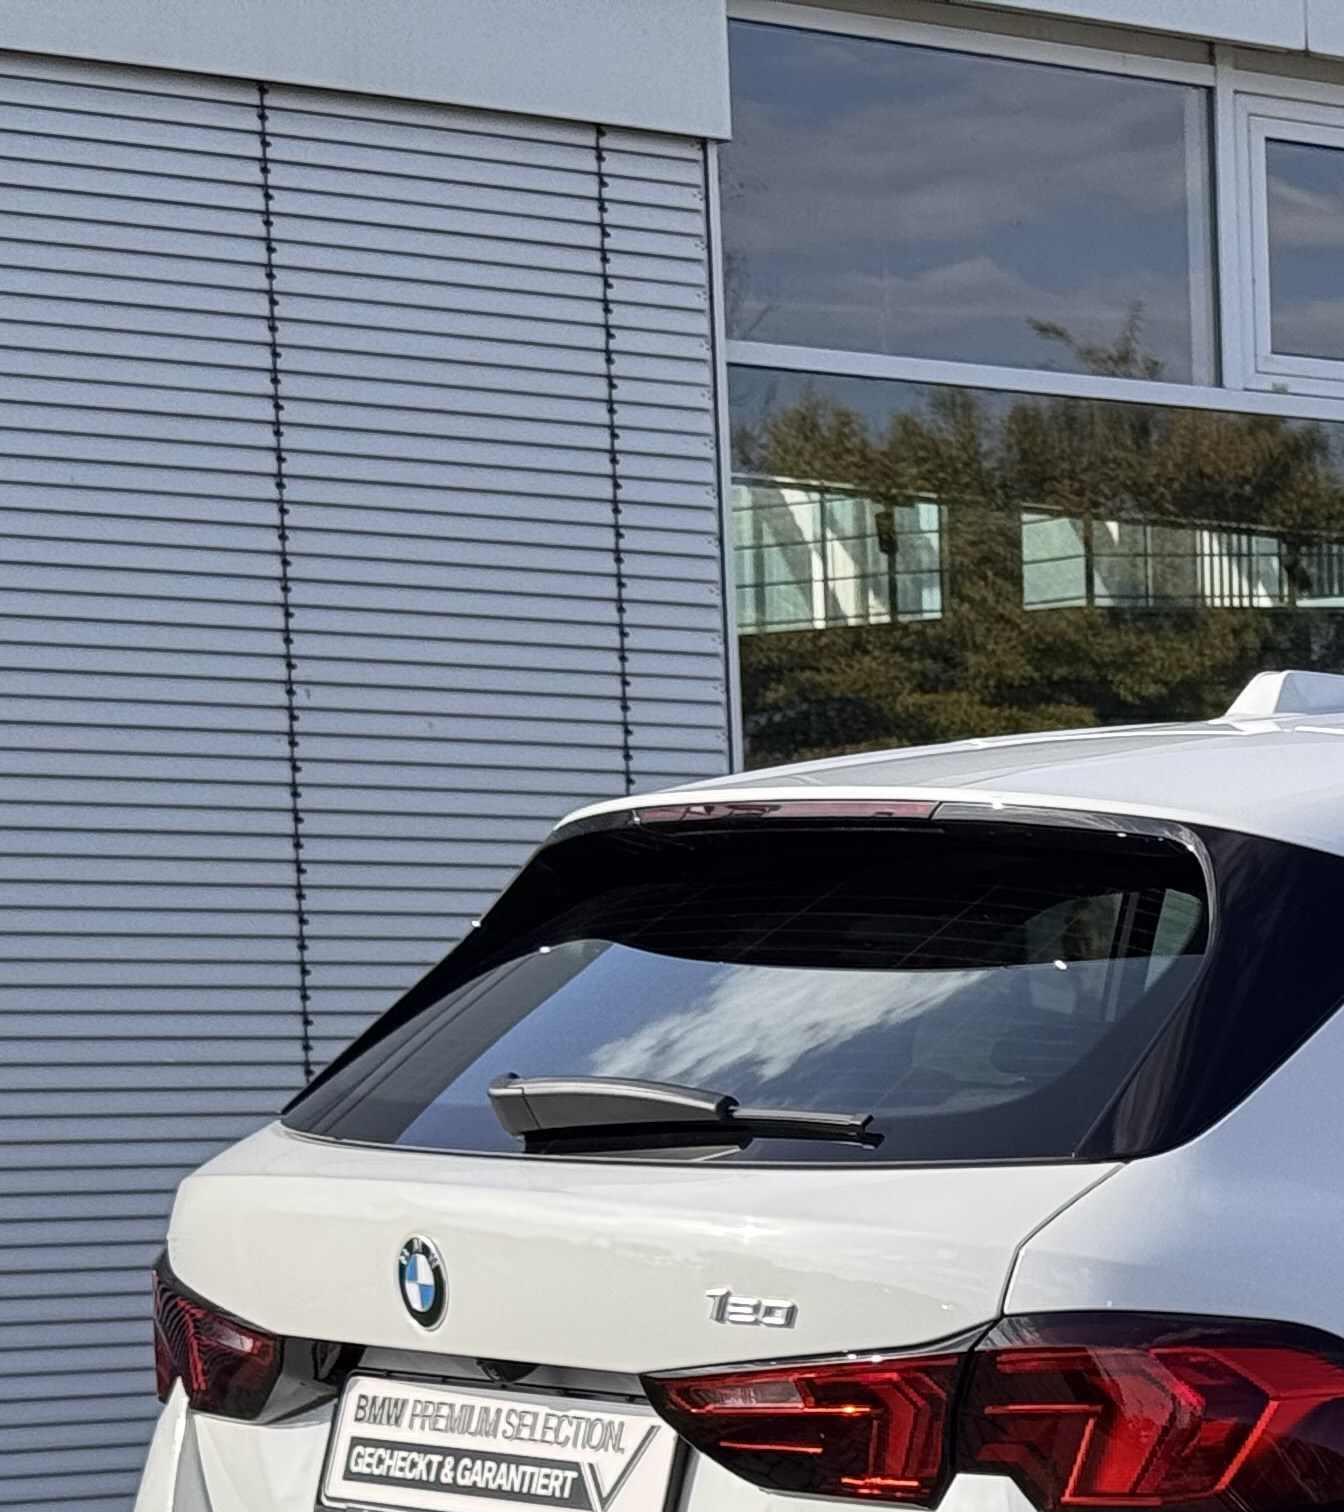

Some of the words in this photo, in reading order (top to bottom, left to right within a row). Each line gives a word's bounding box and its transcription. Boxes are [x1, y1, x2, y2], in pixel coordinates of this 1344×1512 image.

[705, 1288, 798, 1329] 120
[354, 1394, 409, 1427] BMW
[408, 1399, 502, 1440] PREMIUM
[350, 1445, 443, 1482] GECHECKT
[439, 1455, 456, 1485] &
[455, 1456, 579, 1500] GARANTIERT
